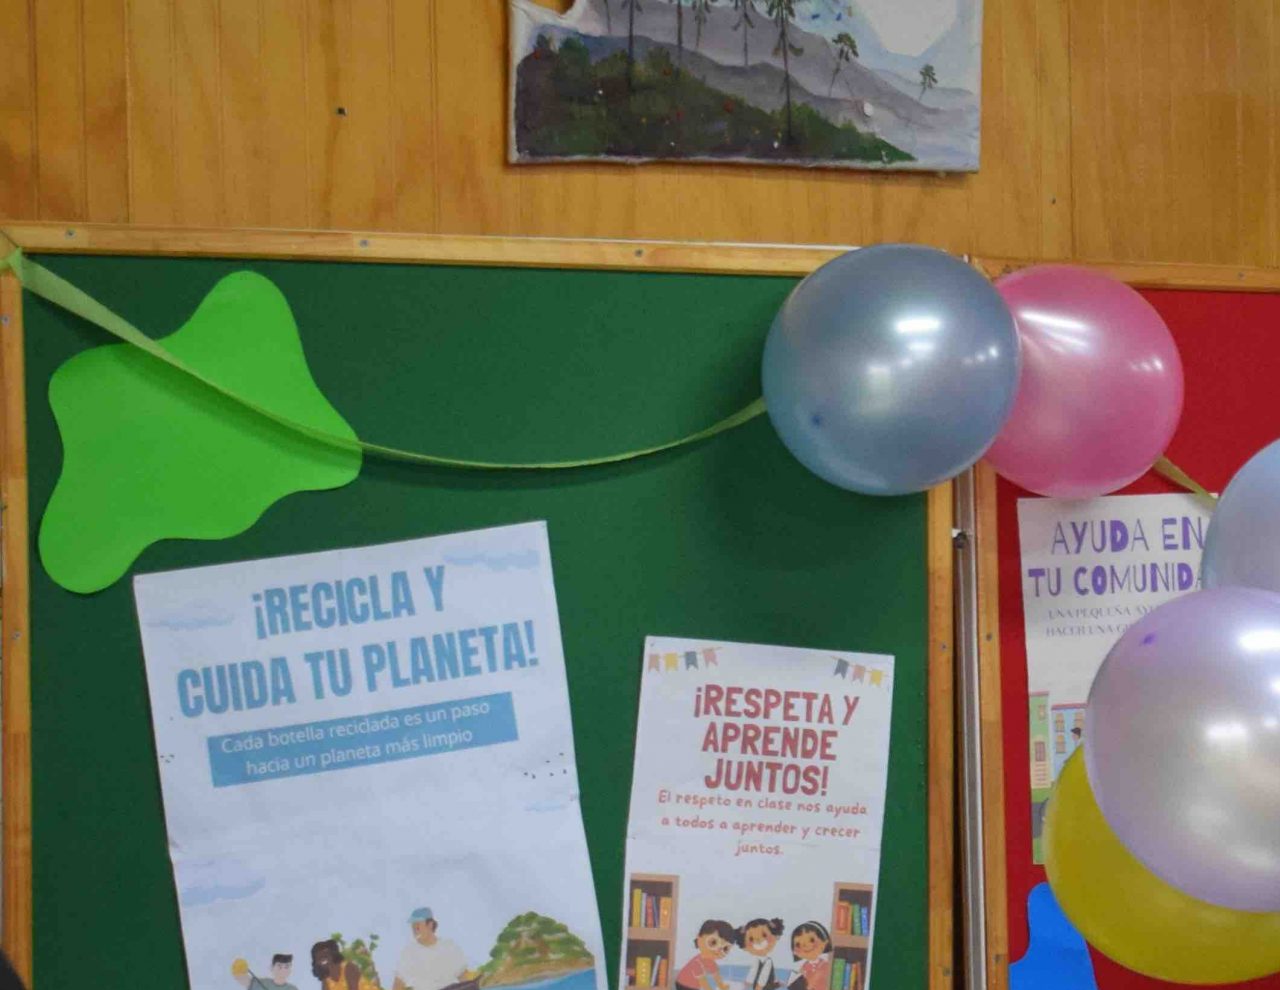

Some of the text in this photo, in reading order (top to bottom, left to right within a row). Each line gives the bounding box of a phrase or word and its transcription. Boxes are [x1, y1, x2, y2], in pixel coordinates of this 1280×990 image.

[1051, 516, 1206, 555] AYUDA EN
[1028, 567, 1061, 597] TU
[252, 565, 445, 640] ¡RECICLA Y
[177, 620, 539, 718] CUIDA TU PLANETA!
[694, 684, 860, 725] ¡RESPETA Y
[222, 702, 489, 753] Cada botella reciclada es un paso
[702, 721, 838, 761] APRENDE
[246, 729, 473, 775] hacia un planeta más limpio
[704, 758, 829, 796] JUNTOS!
[658, 789, 868, 818] El respeto en clase nos ayuda
[661, 816, 861, 839] a todos a aprender y crecer
